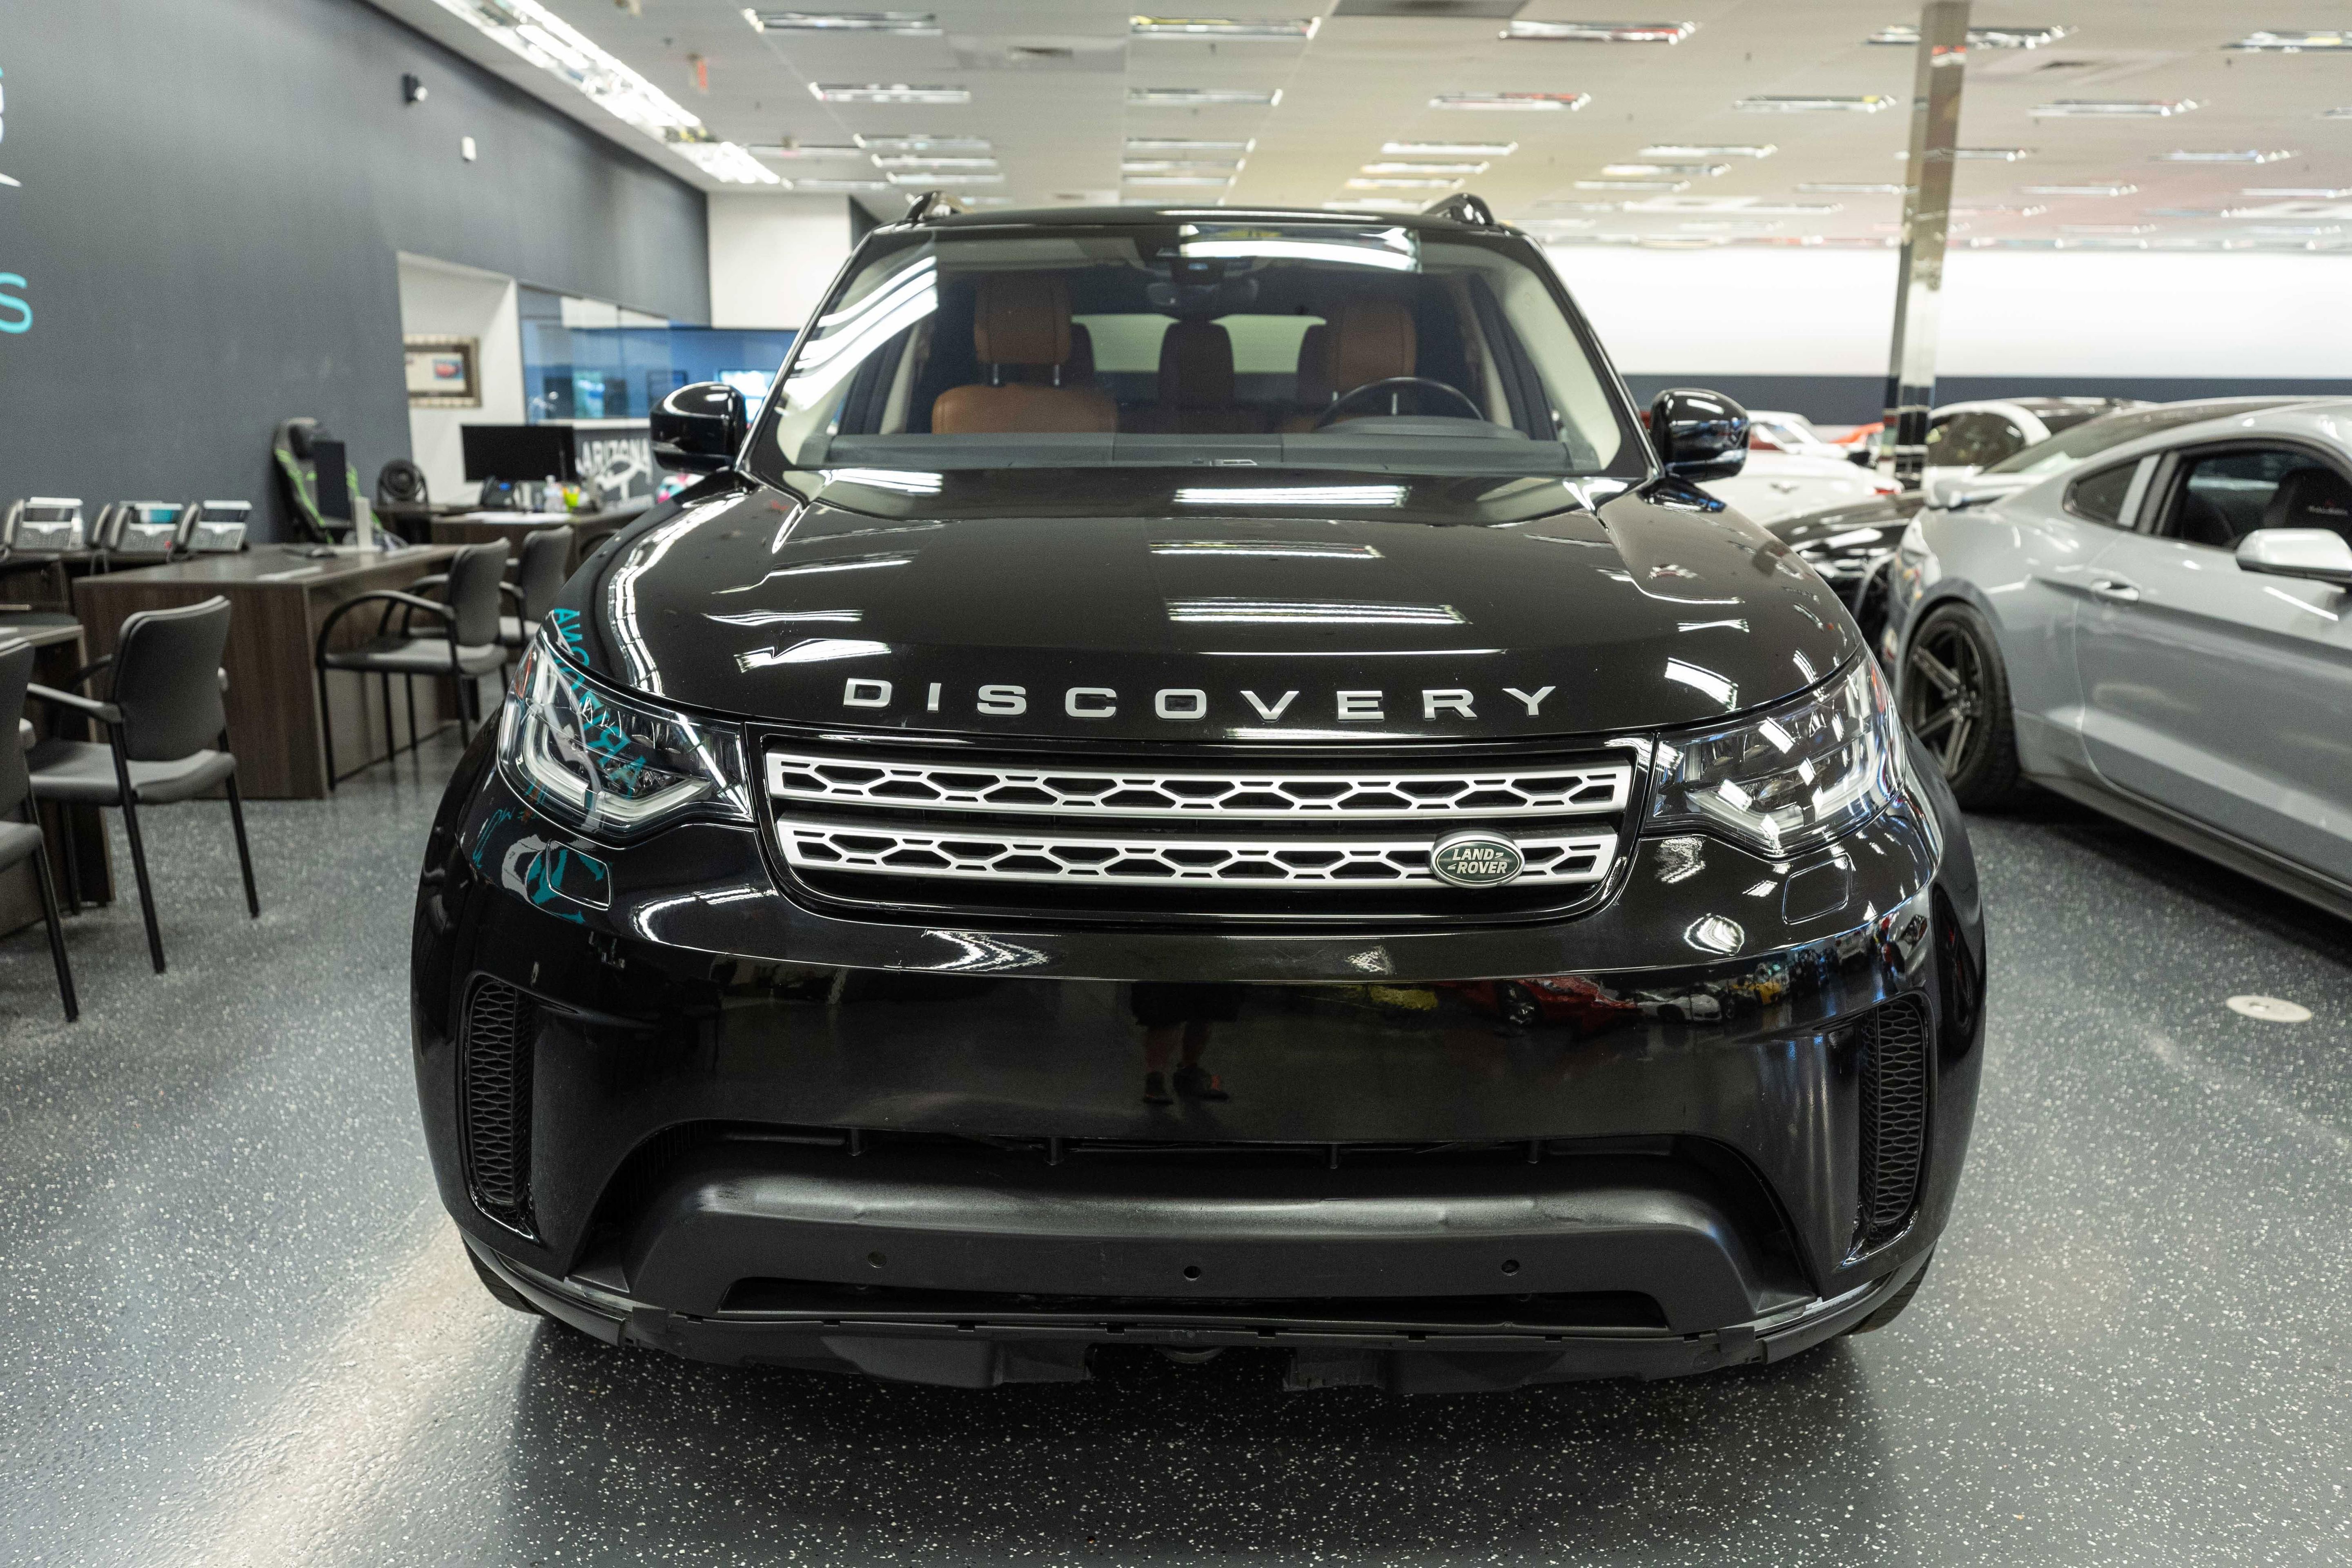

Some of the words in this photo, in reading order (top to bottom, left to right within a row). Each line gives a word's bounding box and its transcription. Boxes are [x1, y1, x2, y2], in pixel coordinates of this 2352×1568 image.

[843, 678, 1557, 721] DISCOVERY
[1452, 849, 1494, 860] LAND
[1457, 861, 1508, 874] ROVER
